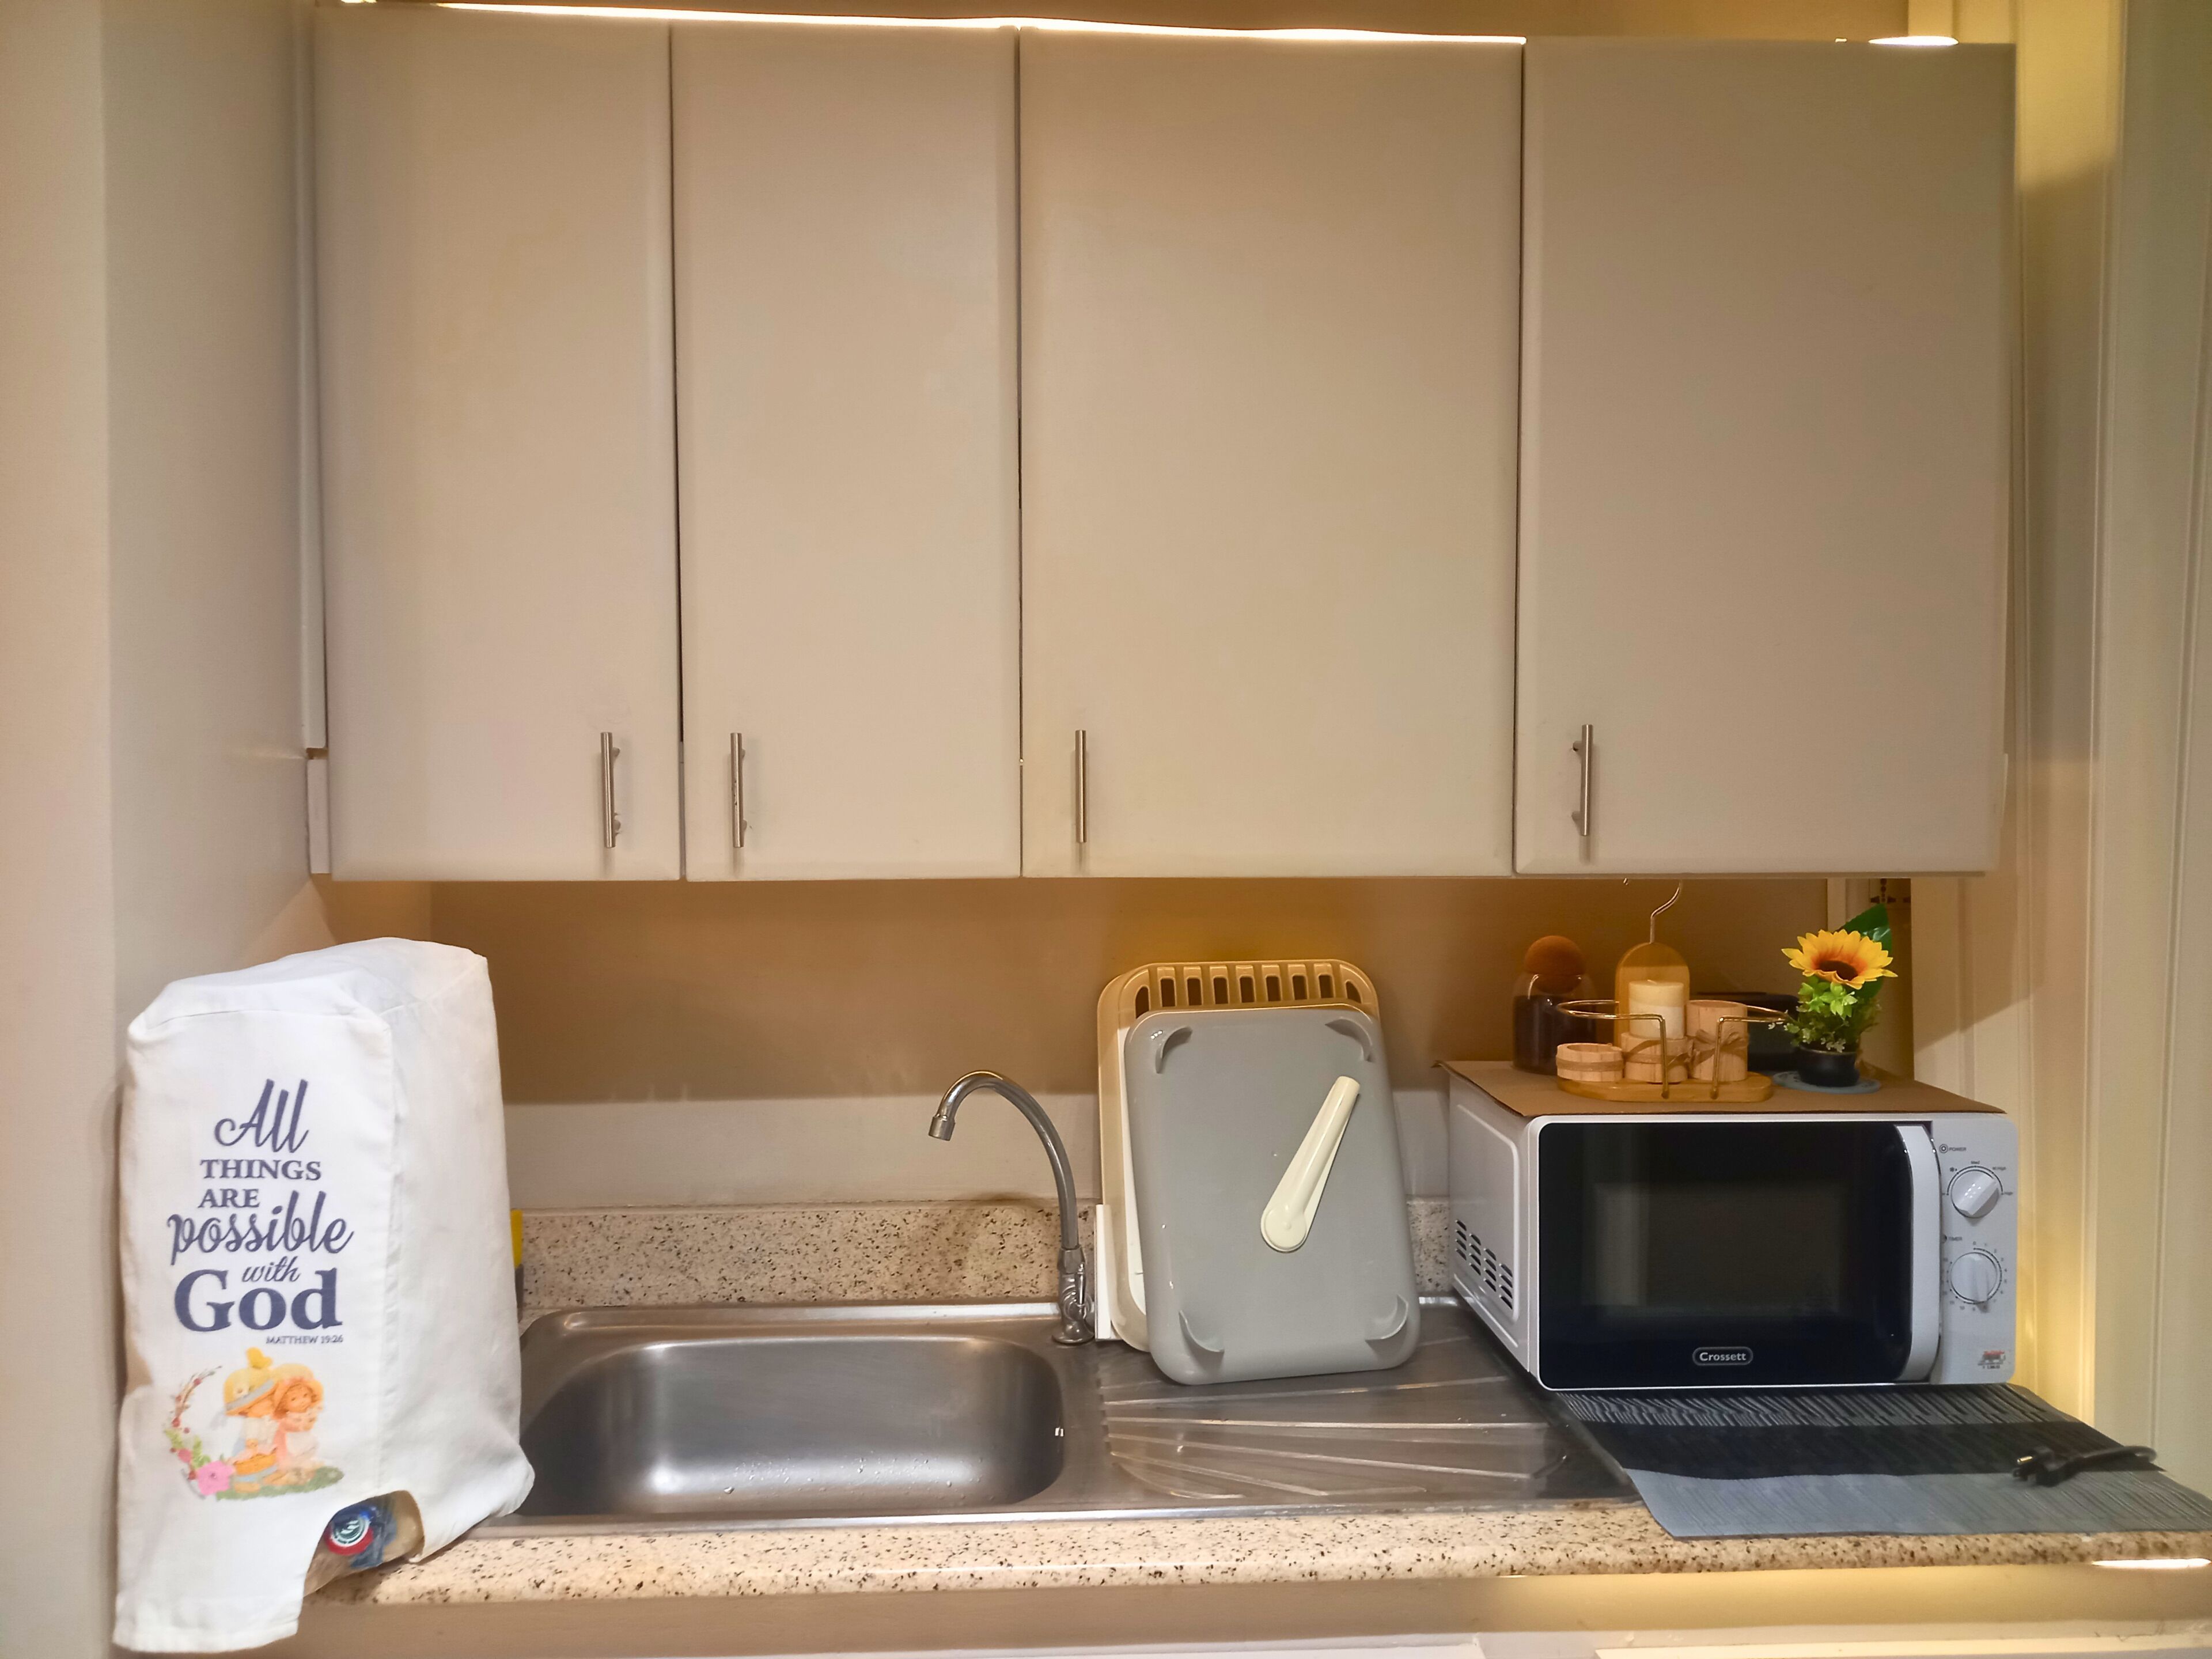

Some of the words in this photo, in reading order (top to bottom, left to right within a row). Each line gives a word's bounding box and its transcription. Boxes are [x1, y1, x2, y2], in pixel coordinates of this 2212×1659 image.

[214, 1079, 309, 1153] All
[200, 1159, 321, 1181] THINGS
[198, 1188, 260, 1209] ARE
[167, 1190, 354, 1266] possible
[241, 1256, 301, 1282] with
[174, 1267, 343, 1332] God
[266, 1335, 319, 1344] MATTHEW
[321, 1334, 344, 1343] 19:26
[1699, 1352, 1747, 1361] Crossett
